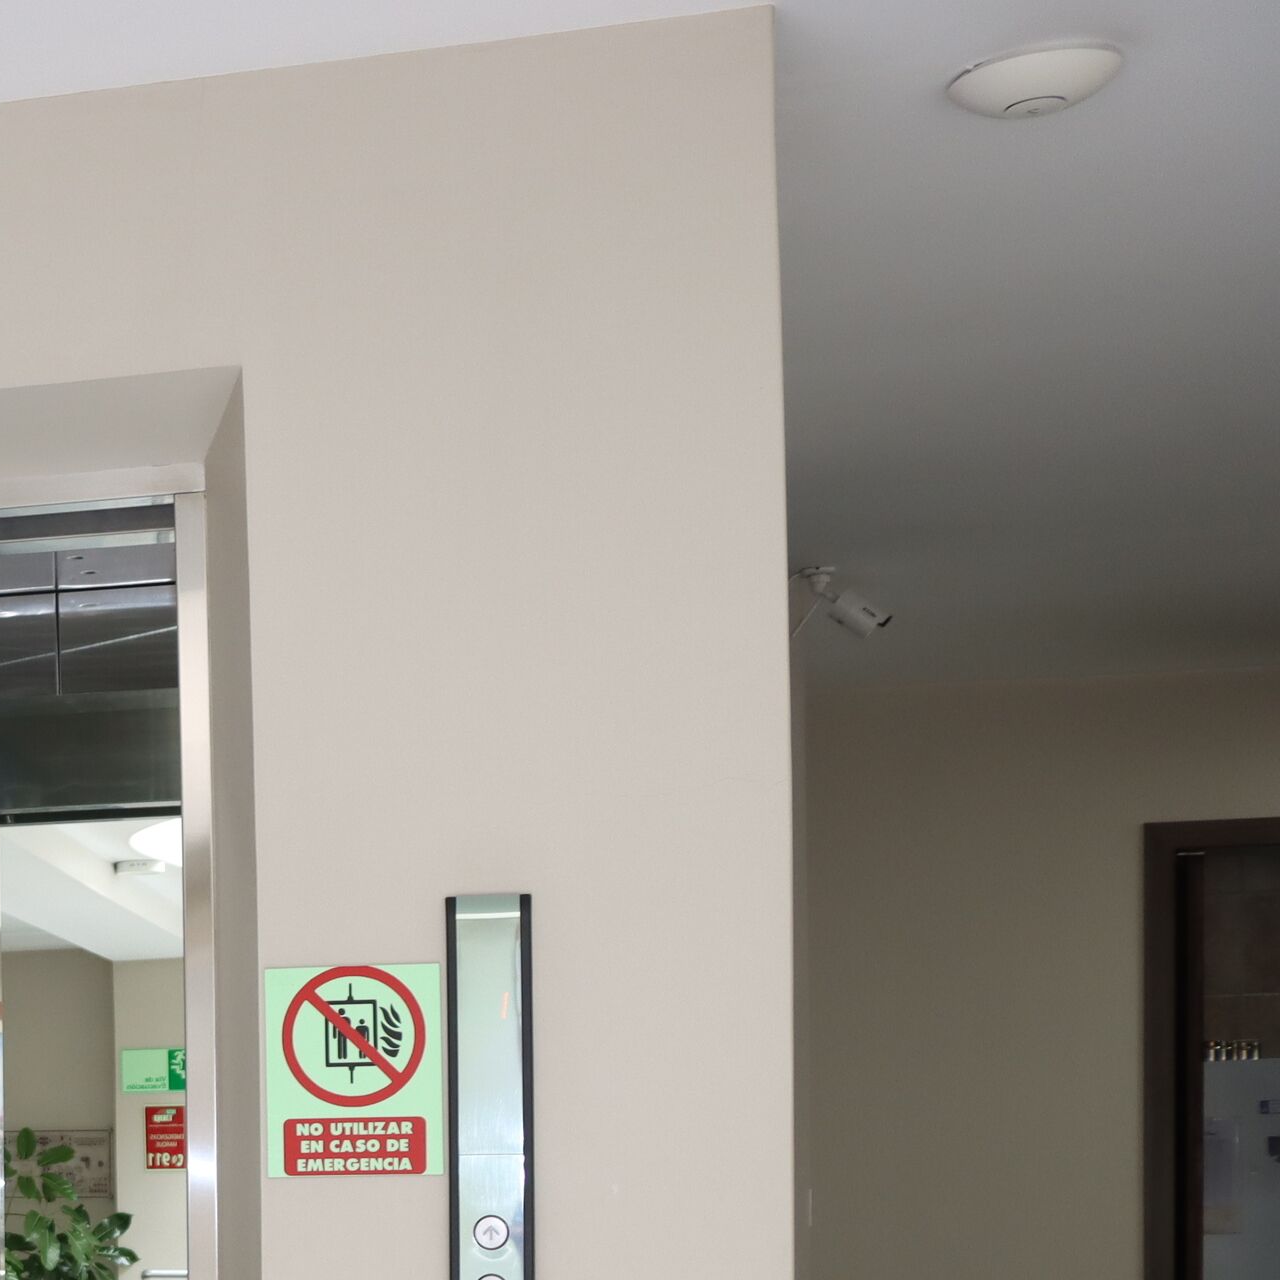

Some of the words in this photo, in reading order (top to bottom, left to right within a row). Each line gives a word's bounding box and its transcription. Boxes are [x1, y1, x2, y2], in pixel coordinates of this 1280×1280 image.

[296, 1123, 324, 1136] NO
[330, 1121, 414, 1136] UTILIZAR
[300, 1140, 324, 1154] EN
[329, 1138, 380, 1153] CASO
[386, 1137, 410, 1152] DE
[296, 1157, 413, 1173] EMERGENCIA
